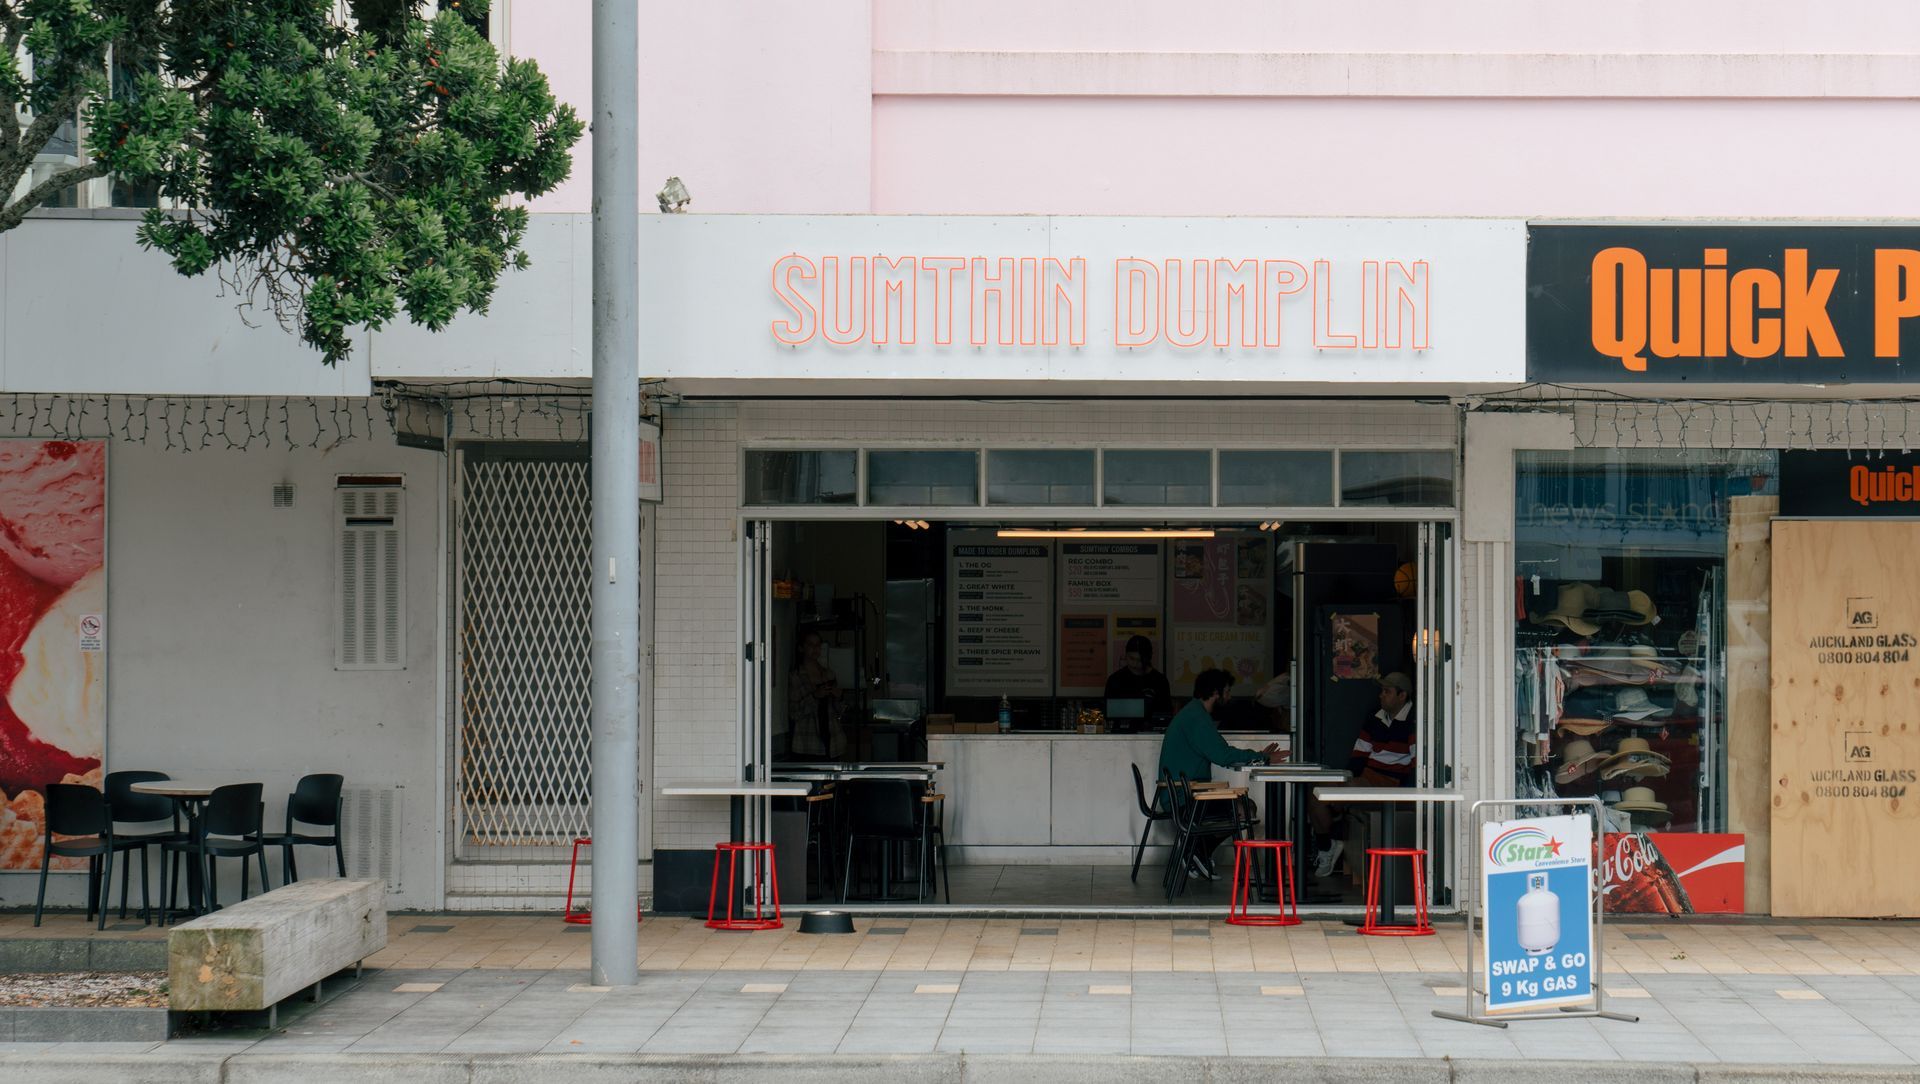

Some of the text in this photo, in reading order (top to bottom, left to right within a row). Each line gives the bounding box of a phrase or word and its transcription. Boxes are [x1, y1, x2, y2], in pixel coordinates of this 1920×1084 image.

[771, 255, 1429, 349] SUMTHIN DUMPLIN
[1592, 247, 1845, 371] Quick
[1529, 502, 1617, 528] news
[1852, 611, 1873, 625] AG
[1209, 632, 1239, 641] CREAM
[1239, 632, 1261, 641] TIME
[1810, 633, 1918, 649] AUCKLAND GLASS
[1818, 649, 1910, 665] 0800 804 804
[1850, 746, 1871, 758] AG
[1874, 769, 1917, 783] GLASS
[1815, 786, 1850, 798] 0800
[1852, 786, 1878, 798] 804
[1507, 843, 1554, 862] Starz
[1535, 856, 1586, 867] Convenience Store
[1492, 952, 1586, 976] SWAP & GO
[1501, 974, 1577, 997] 9 Kg GAS
